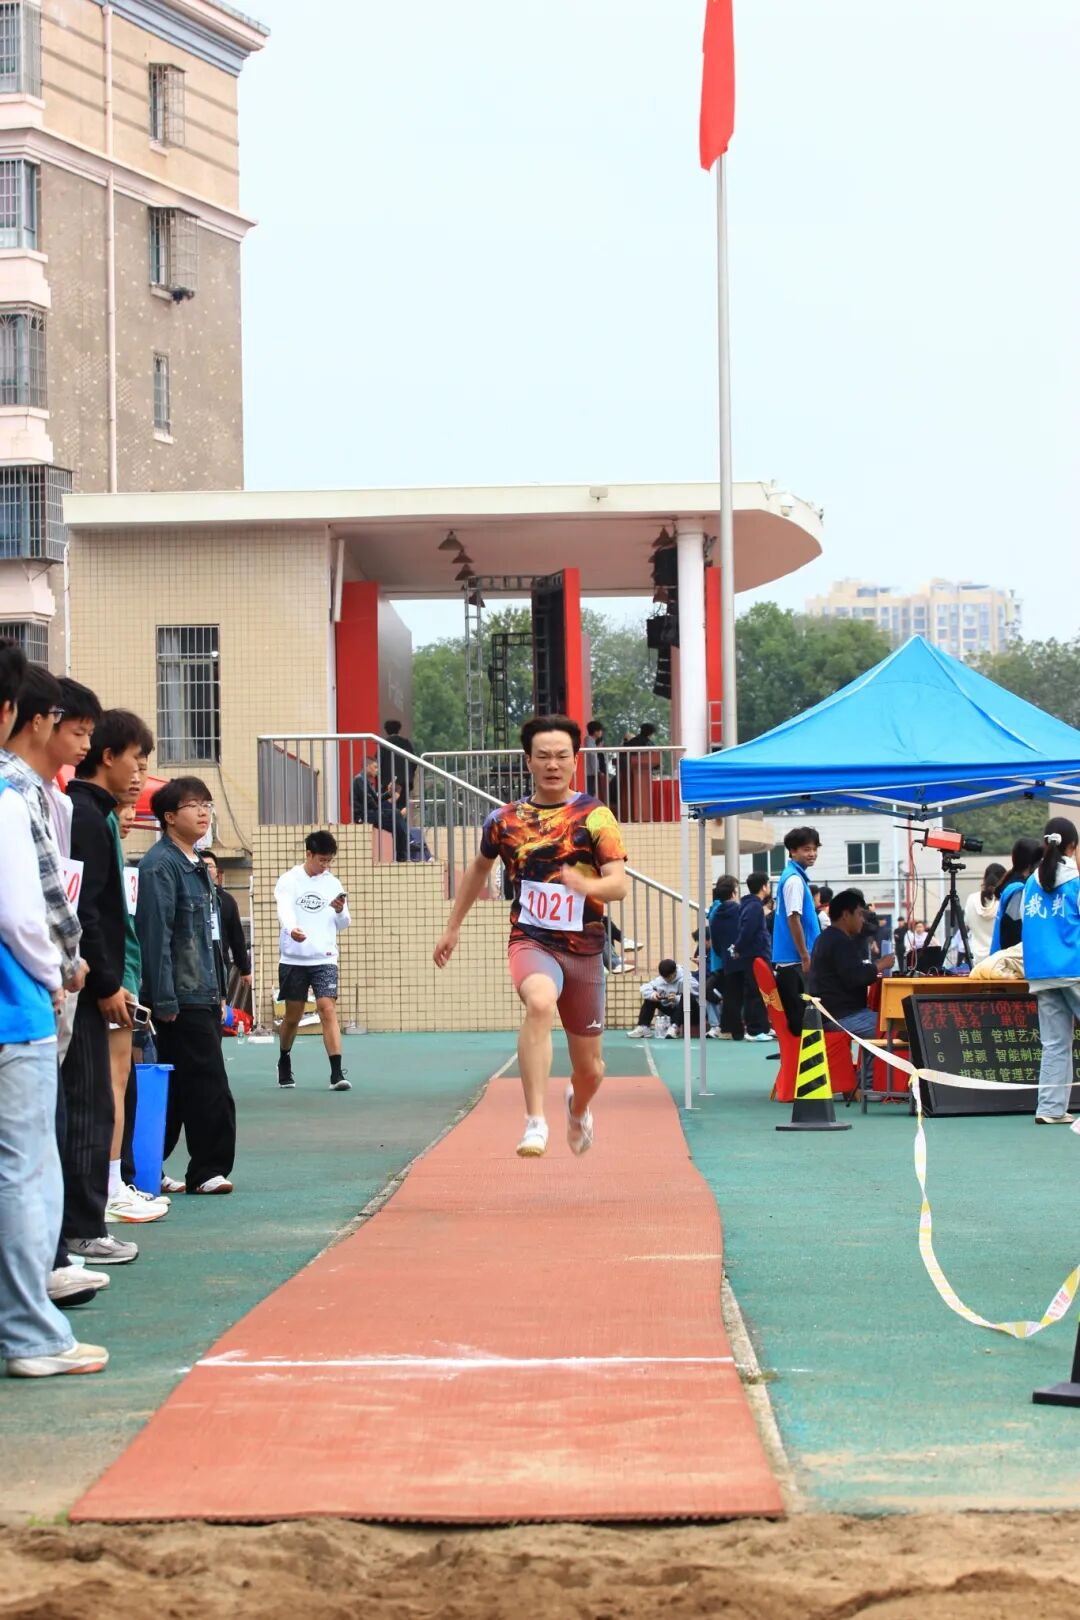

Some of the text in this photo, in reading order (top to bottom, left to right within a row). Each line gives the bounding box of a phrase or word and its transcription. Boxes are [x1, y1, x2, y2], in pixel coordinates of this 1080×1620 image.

[528, 890, 574, 922] 1021
[1025, 893, 1066, 919] 裁判
[933, 1032, 941, 1044] 5
[937, 1051, 945, 1063] 6
